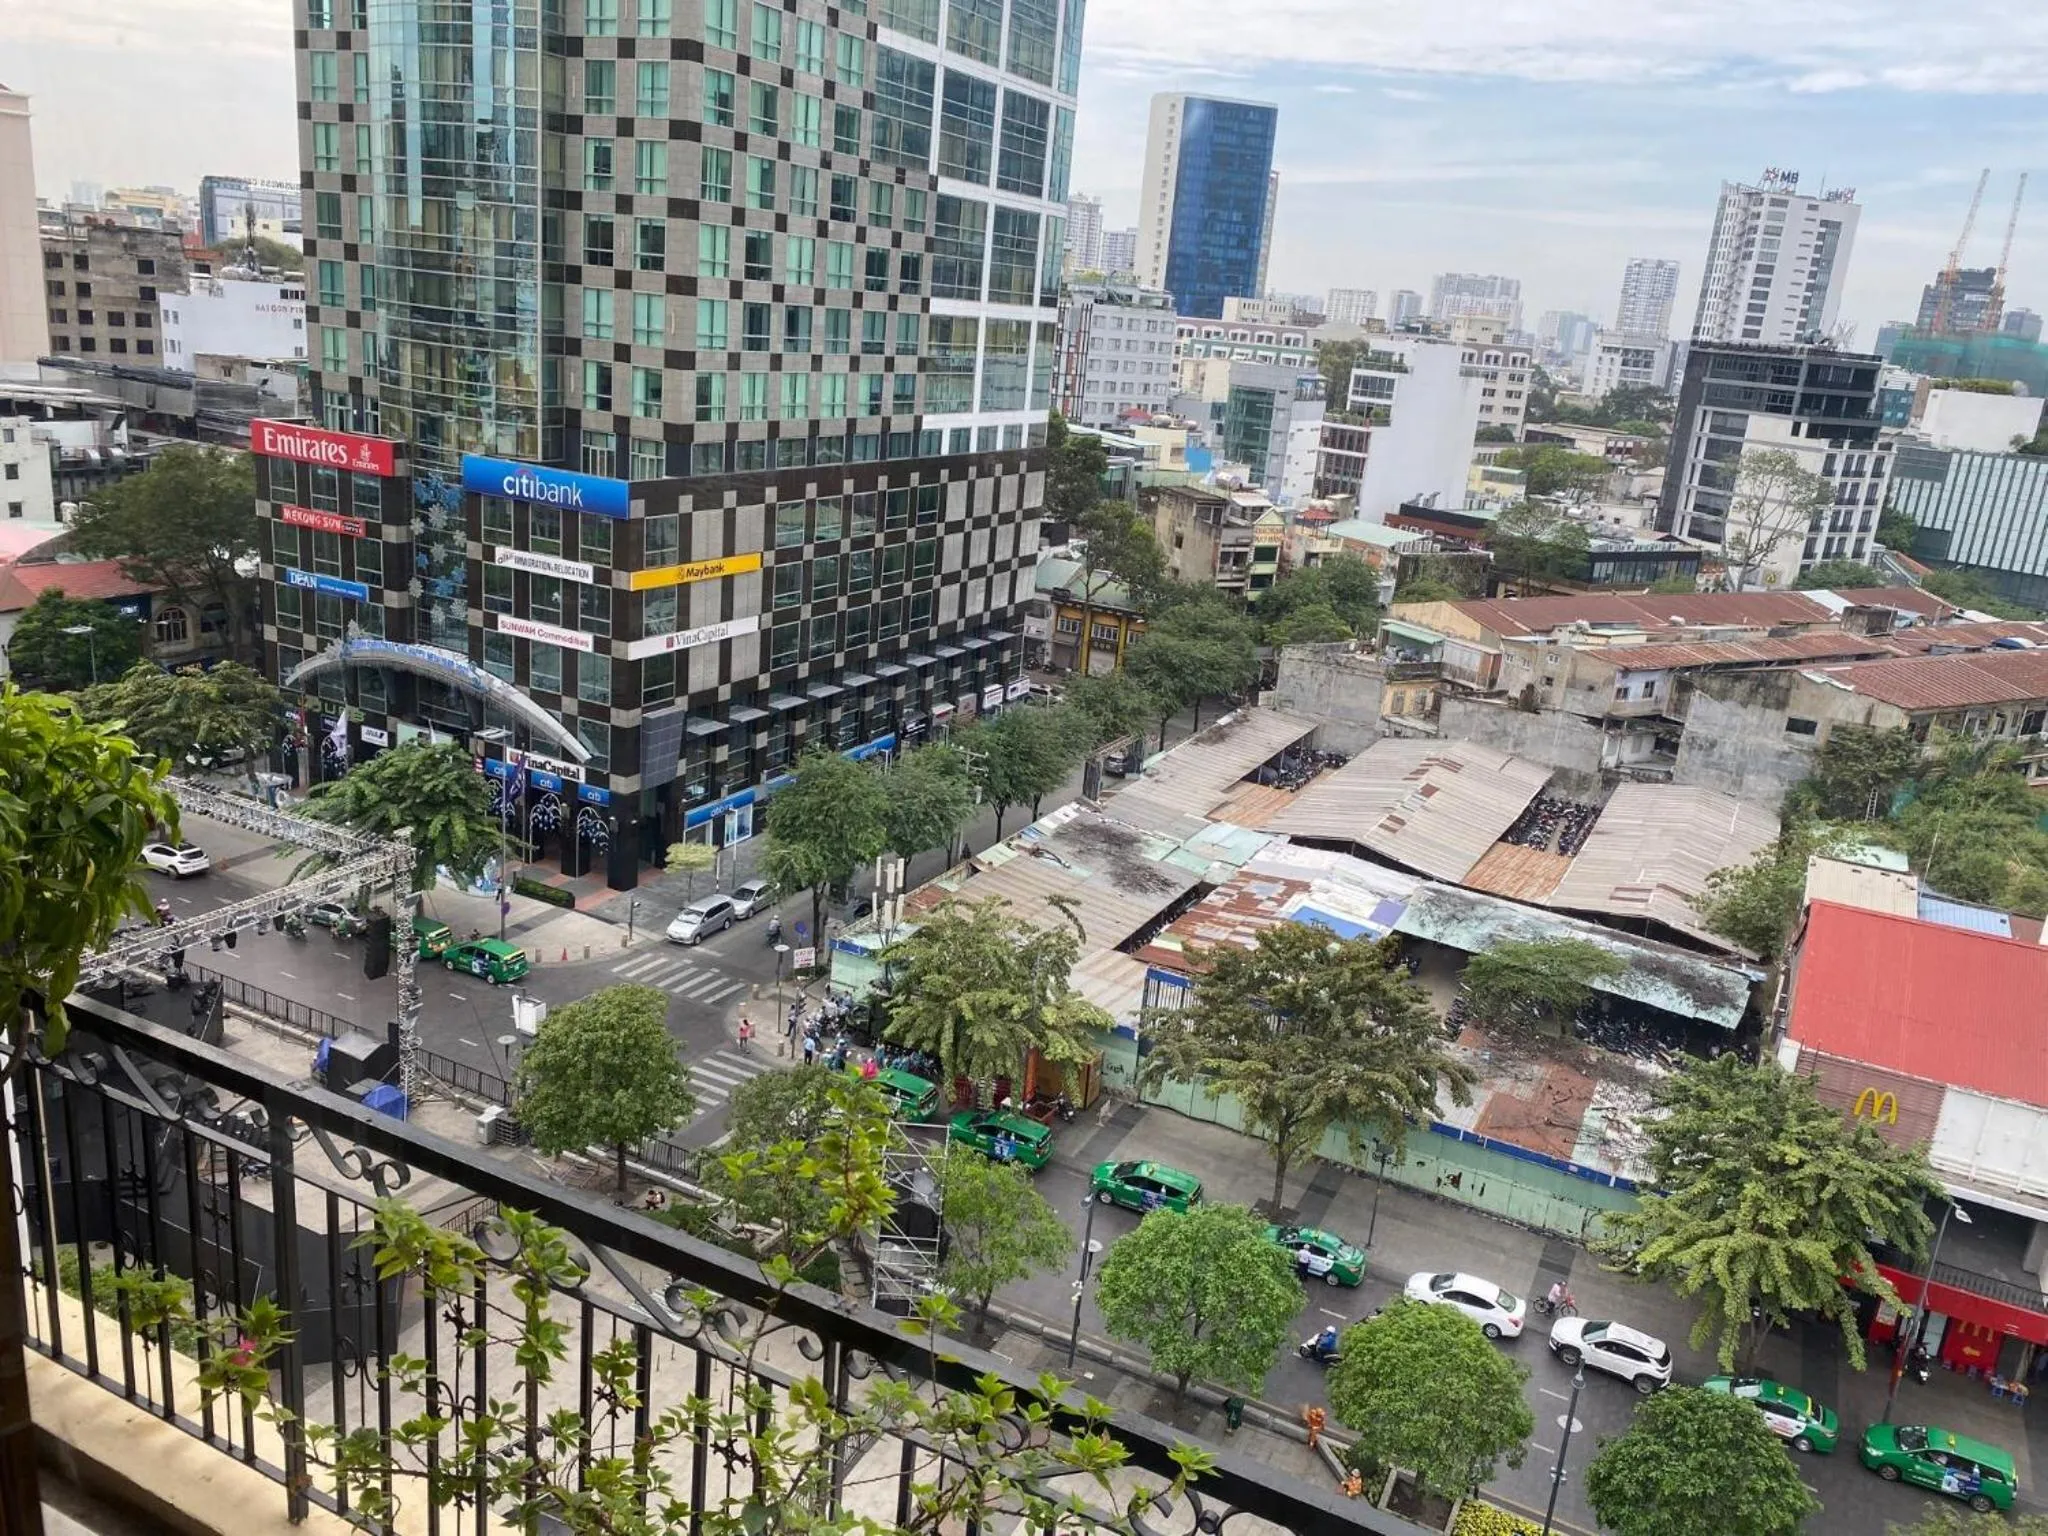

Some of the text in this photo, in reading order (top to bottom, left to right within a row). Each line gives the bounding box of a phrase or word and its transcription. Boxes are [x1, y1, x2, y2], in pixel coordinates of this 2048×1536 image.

[263, 426, 348, 464] Emirates
[503, 474, 584, 508] citibank
[686, 562, 725, 578] Maybank
[675, 623, 729, 646] VinaCapital
